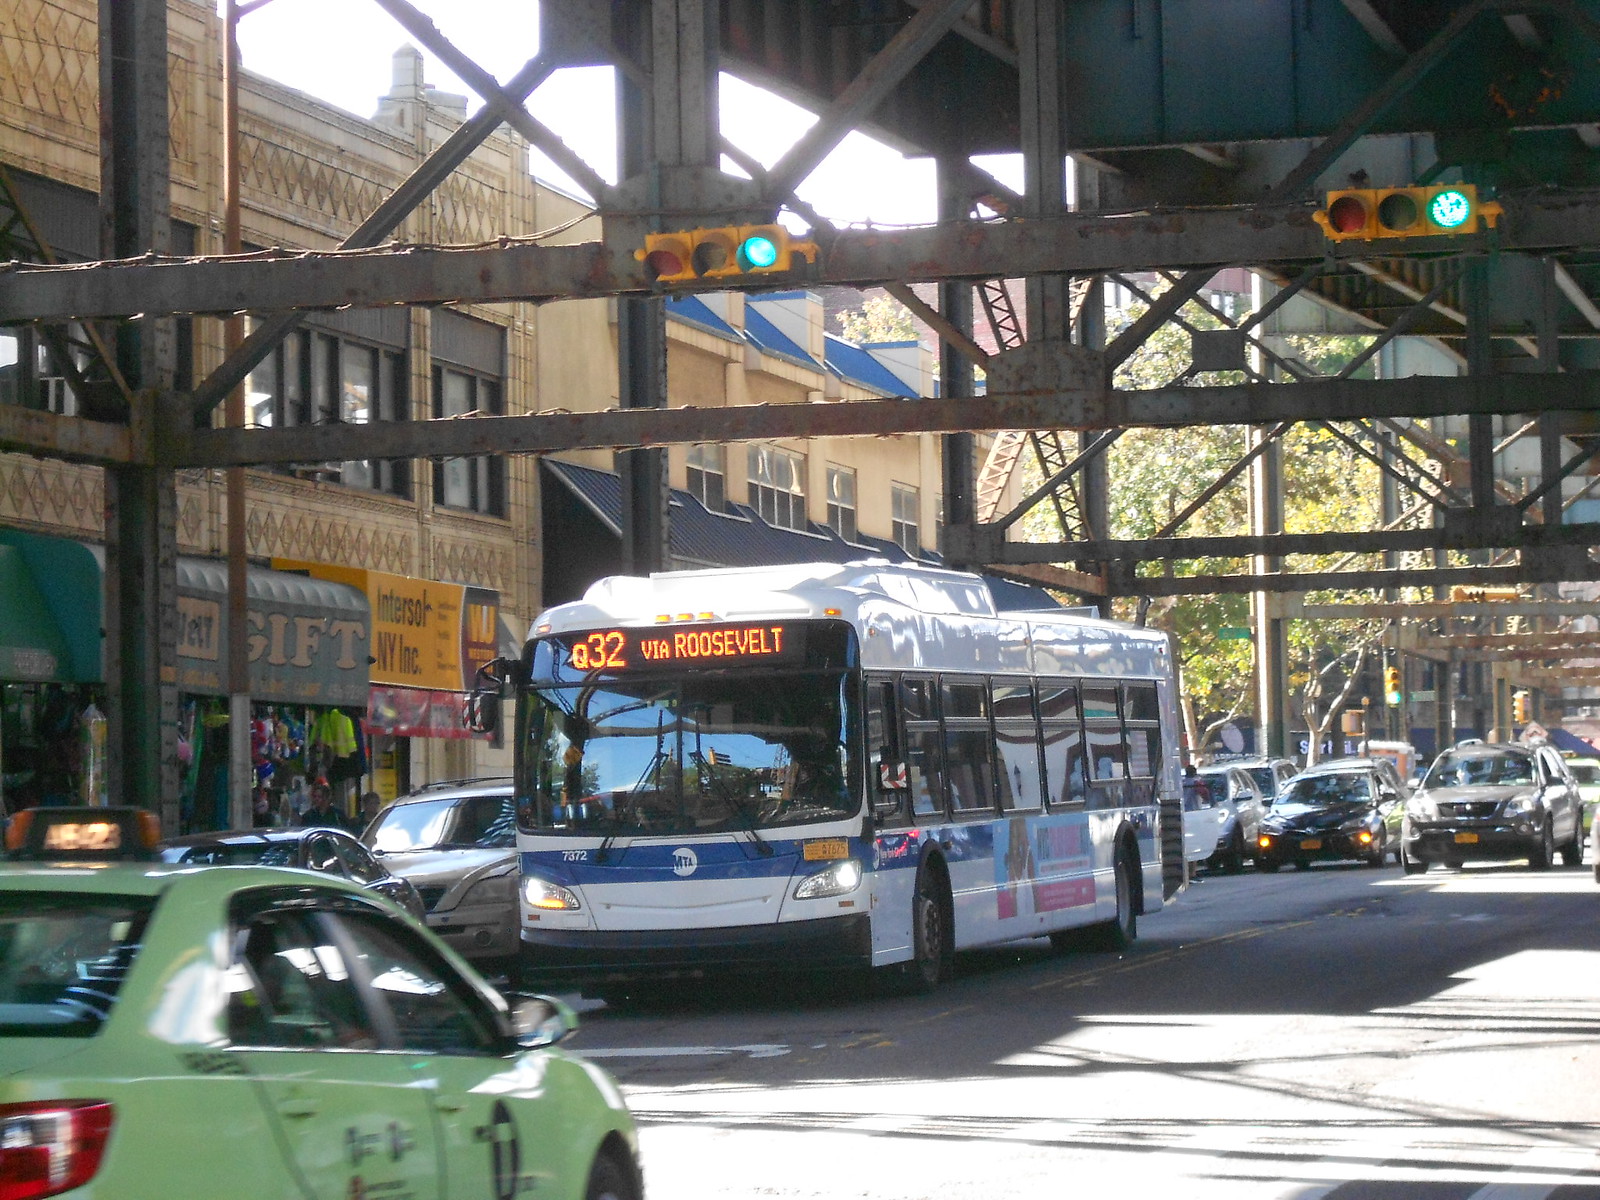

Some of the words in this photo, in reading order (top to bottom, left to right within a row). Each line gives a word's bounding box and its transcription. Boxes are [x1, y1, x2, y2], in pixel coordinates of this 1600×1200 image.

[247, 610, 366, 669] GIFT
[377, 631, 397, 671] NY
[399, 634, 422, 675] Inc.
[572, 631, 626, 669] Q32
[641, 641, 670, 660] VIA
[674, 627, 783, 658] ROOSEVELT
[562, 851, 587, 861] 7372
